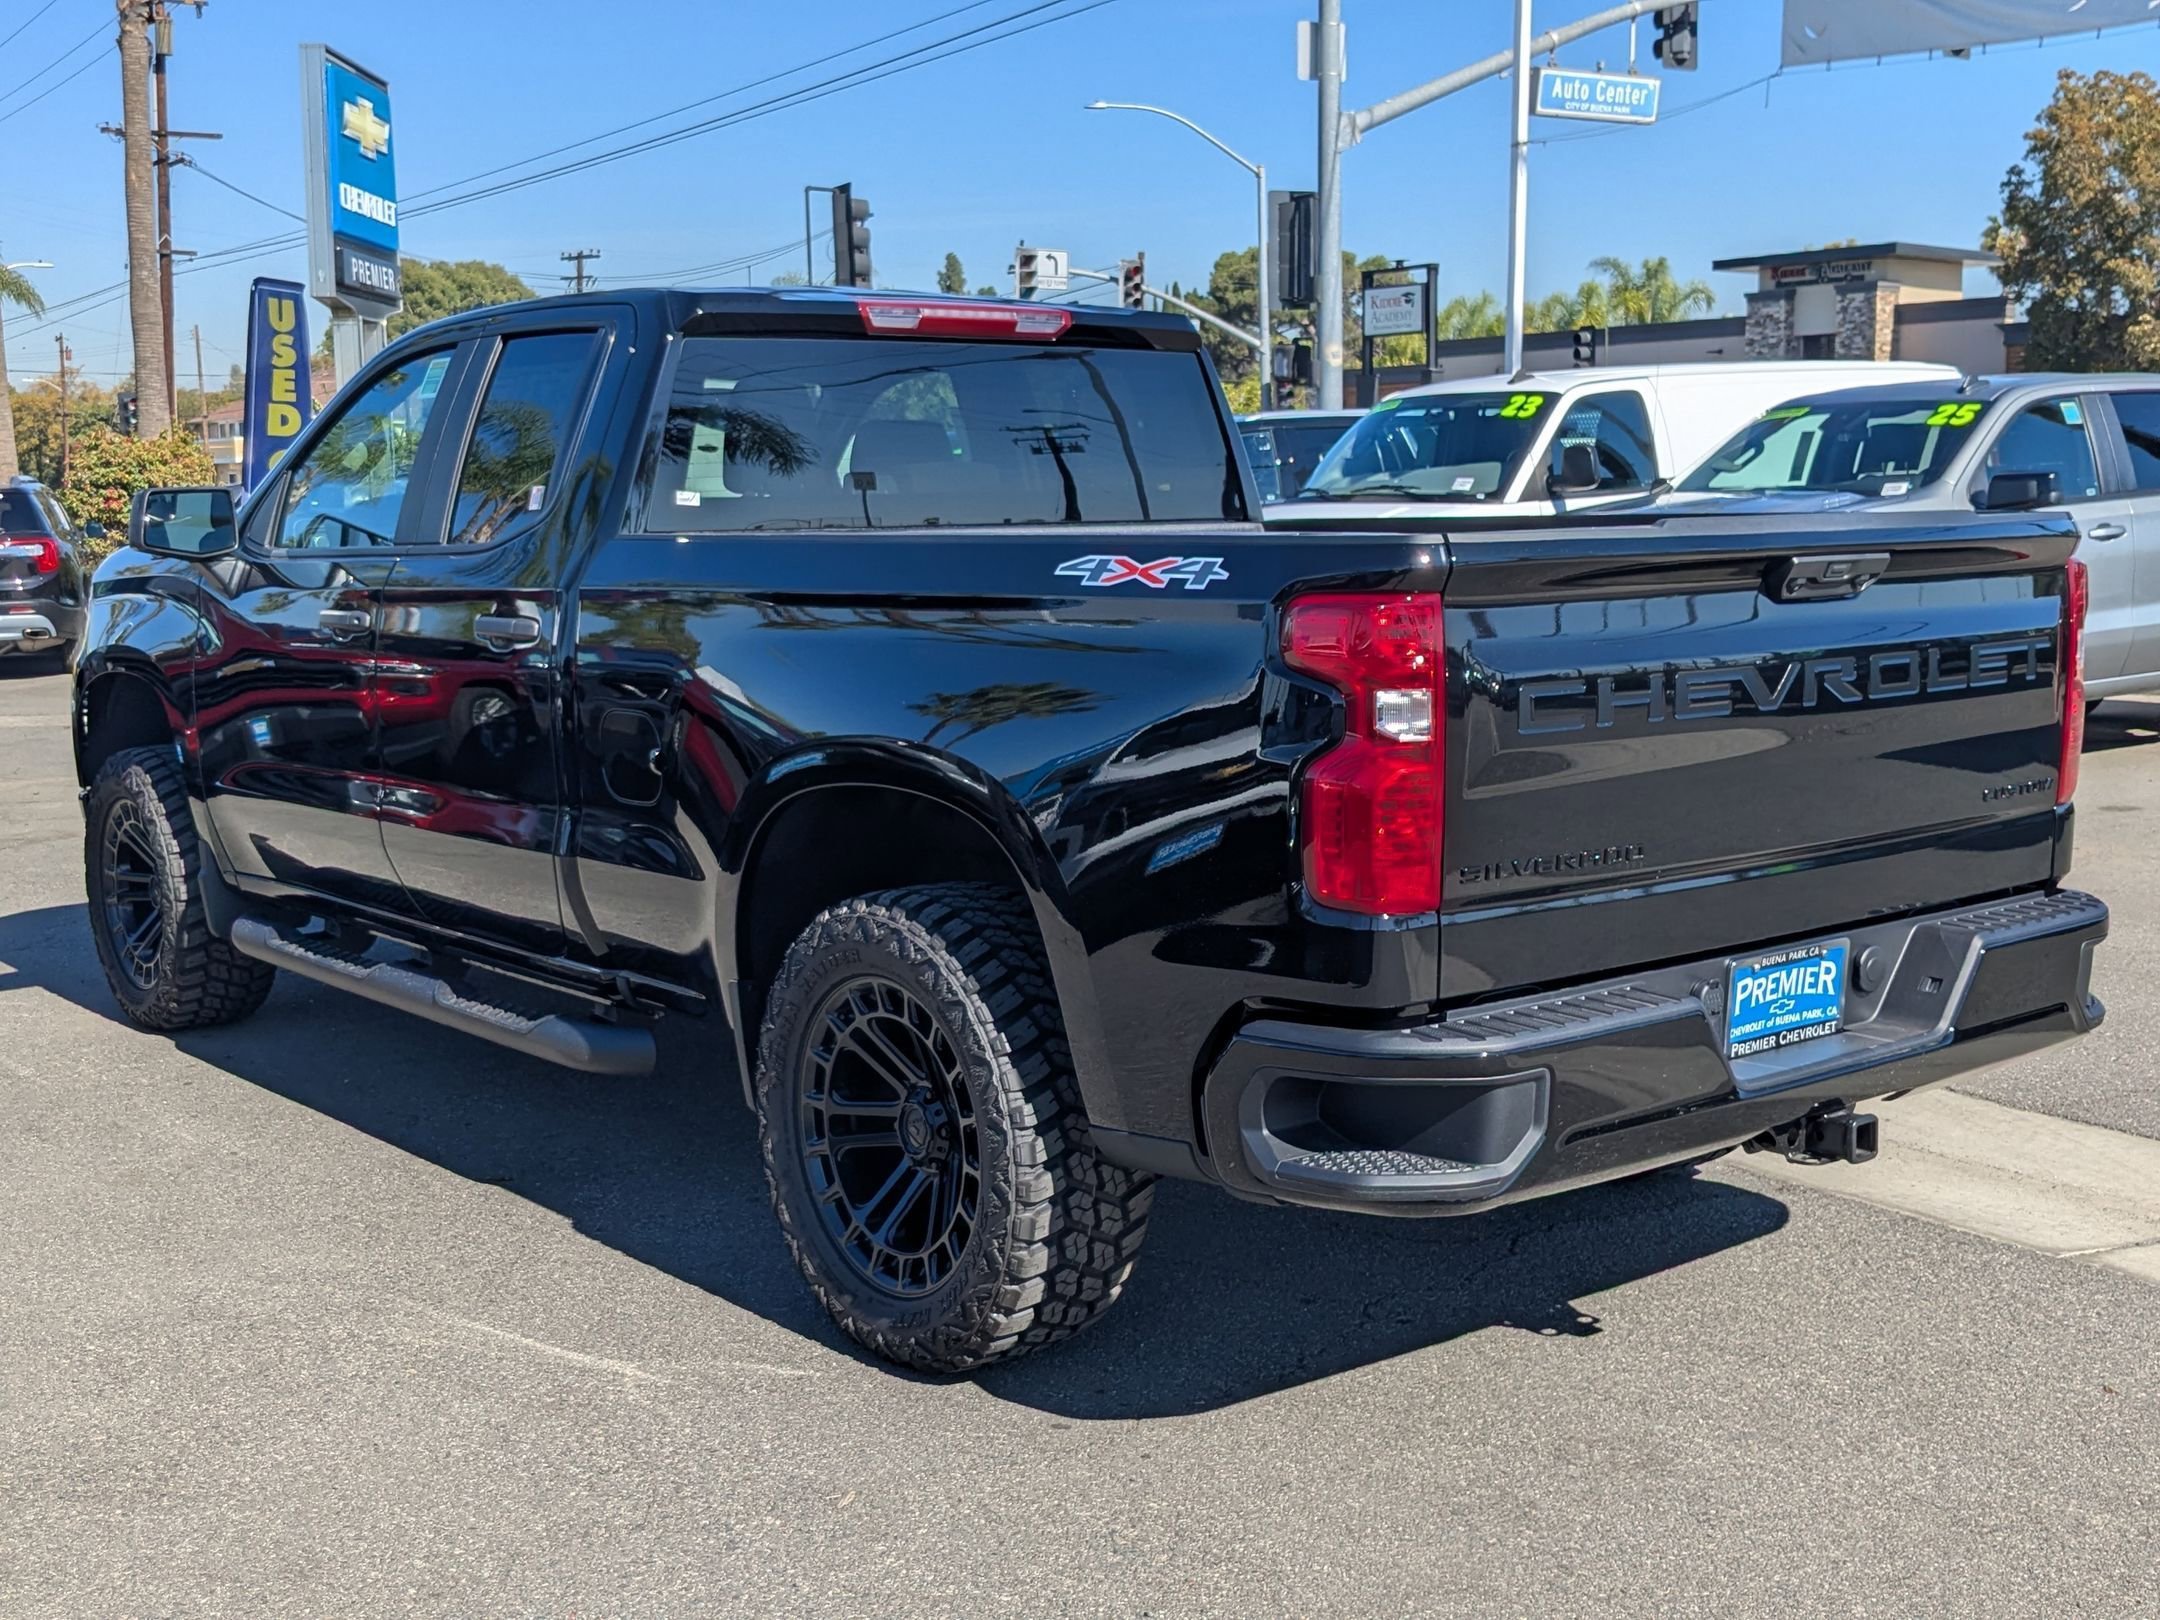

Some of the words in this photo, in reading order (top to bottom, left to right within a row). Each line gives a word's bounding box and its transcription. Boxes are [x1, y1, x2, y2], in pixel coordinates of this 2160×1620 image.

[1551, 77, 1590, 101] Auto
[1596, 80, 1649, 106] Center
[339, 182, 397, 227] CHEVROLET
[351, 257, 396, 292] PREMIER
[267, 297, 302, 437] USED
[1501, 394, 1544, 418] 23
[1926, 403, 1982, 427] 25
[1517, 636, 2052, 734] CHEVROLET
[1761, 953, 1787, 967] BUENA
[1809, 946, 1819, 957] CA
[1733, 960, 1837, 1017] PREMIER
[1730, 1019, 1766, 1039] CHEVROLET
[1766, 1017, 1775, 1029] of
[1775, 1013, 1800, 1026] BUENA
[1826, 1005, 1838, 1016] CA
[1730, 1034, 1776, 1058] PREMIER
[1779, 1020, 1838, 1046] CHEVROLET
